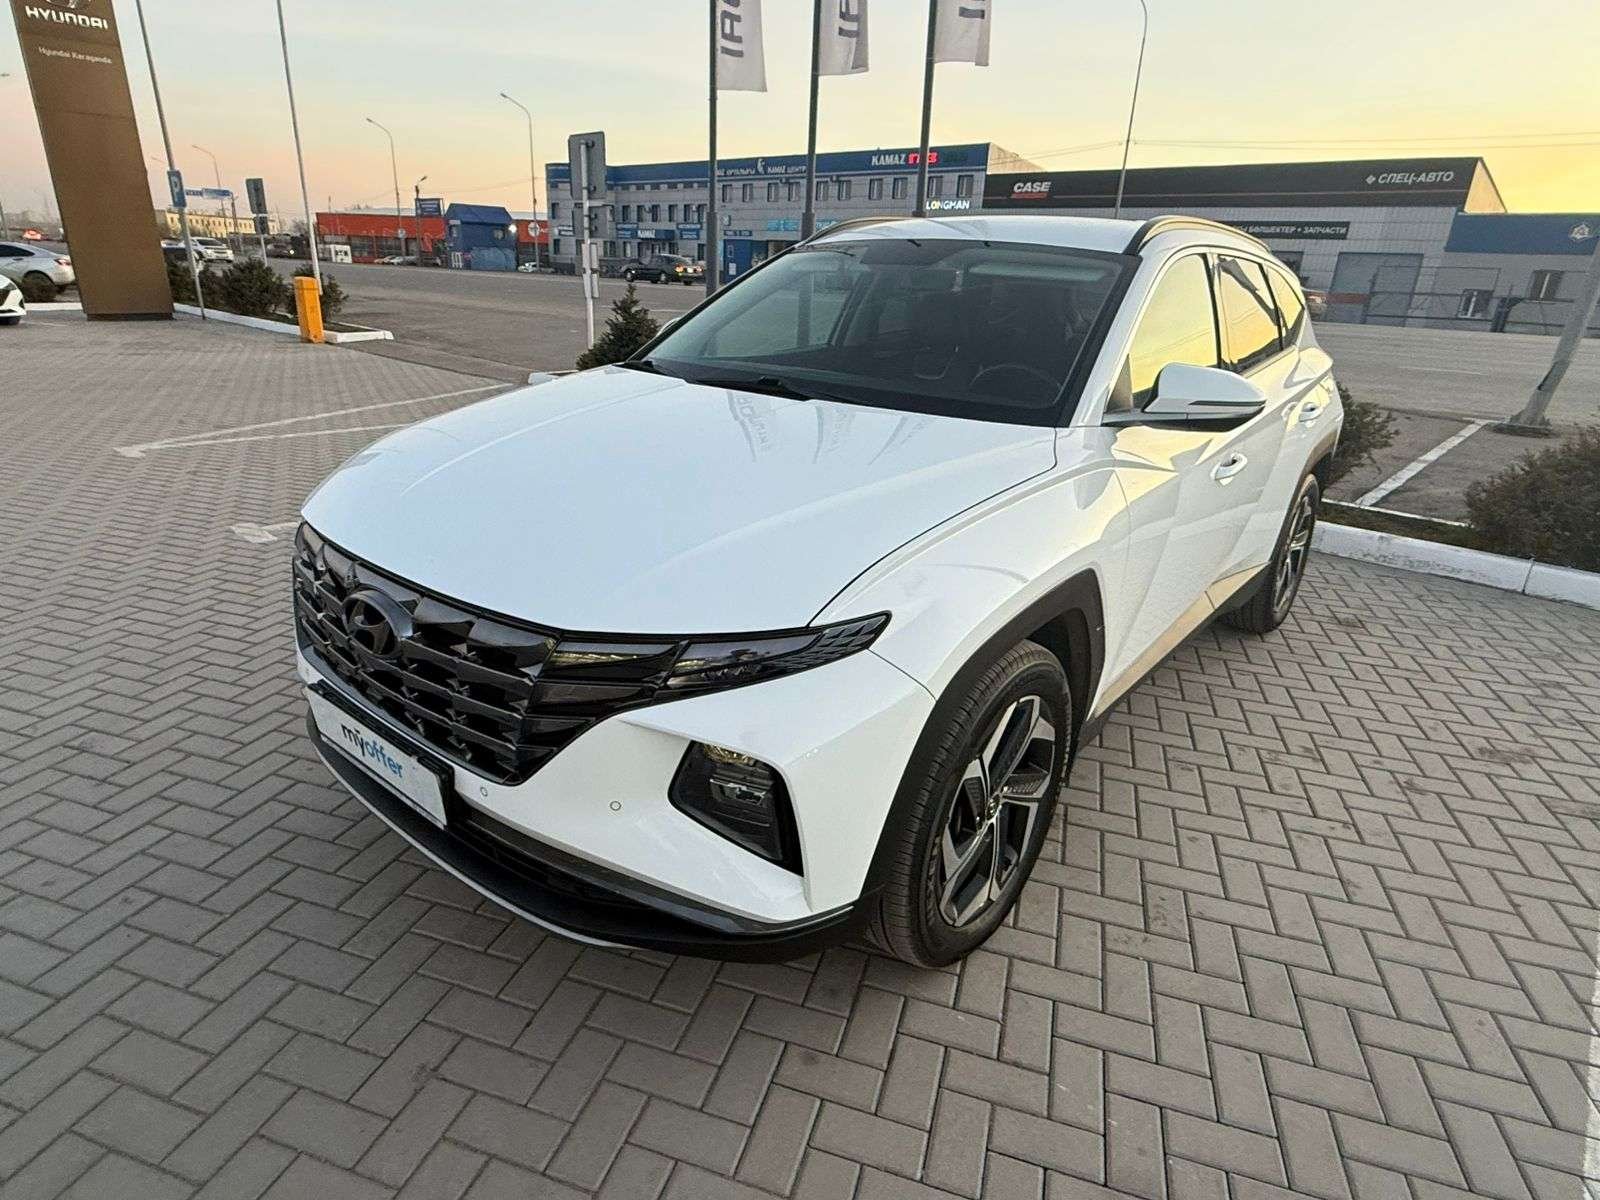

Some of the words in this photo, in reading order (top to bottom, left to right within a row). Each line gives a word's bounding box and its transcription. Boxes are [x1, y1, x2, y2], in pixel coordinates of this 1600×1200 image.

[25, 5, 108, 29] HYUNDAI
[871, 153, 906, 165] KAMAZ
[1378, 171, 1454, 185] СПЕЦ-АВТО
[1013, 181, 1052, 193] CASE
[926, 200, 970, 210] LONGMAN
[1303, 226, 1347, 234] ЗАПЧАСТИ
[340, 722, 404, 778] myoffer
